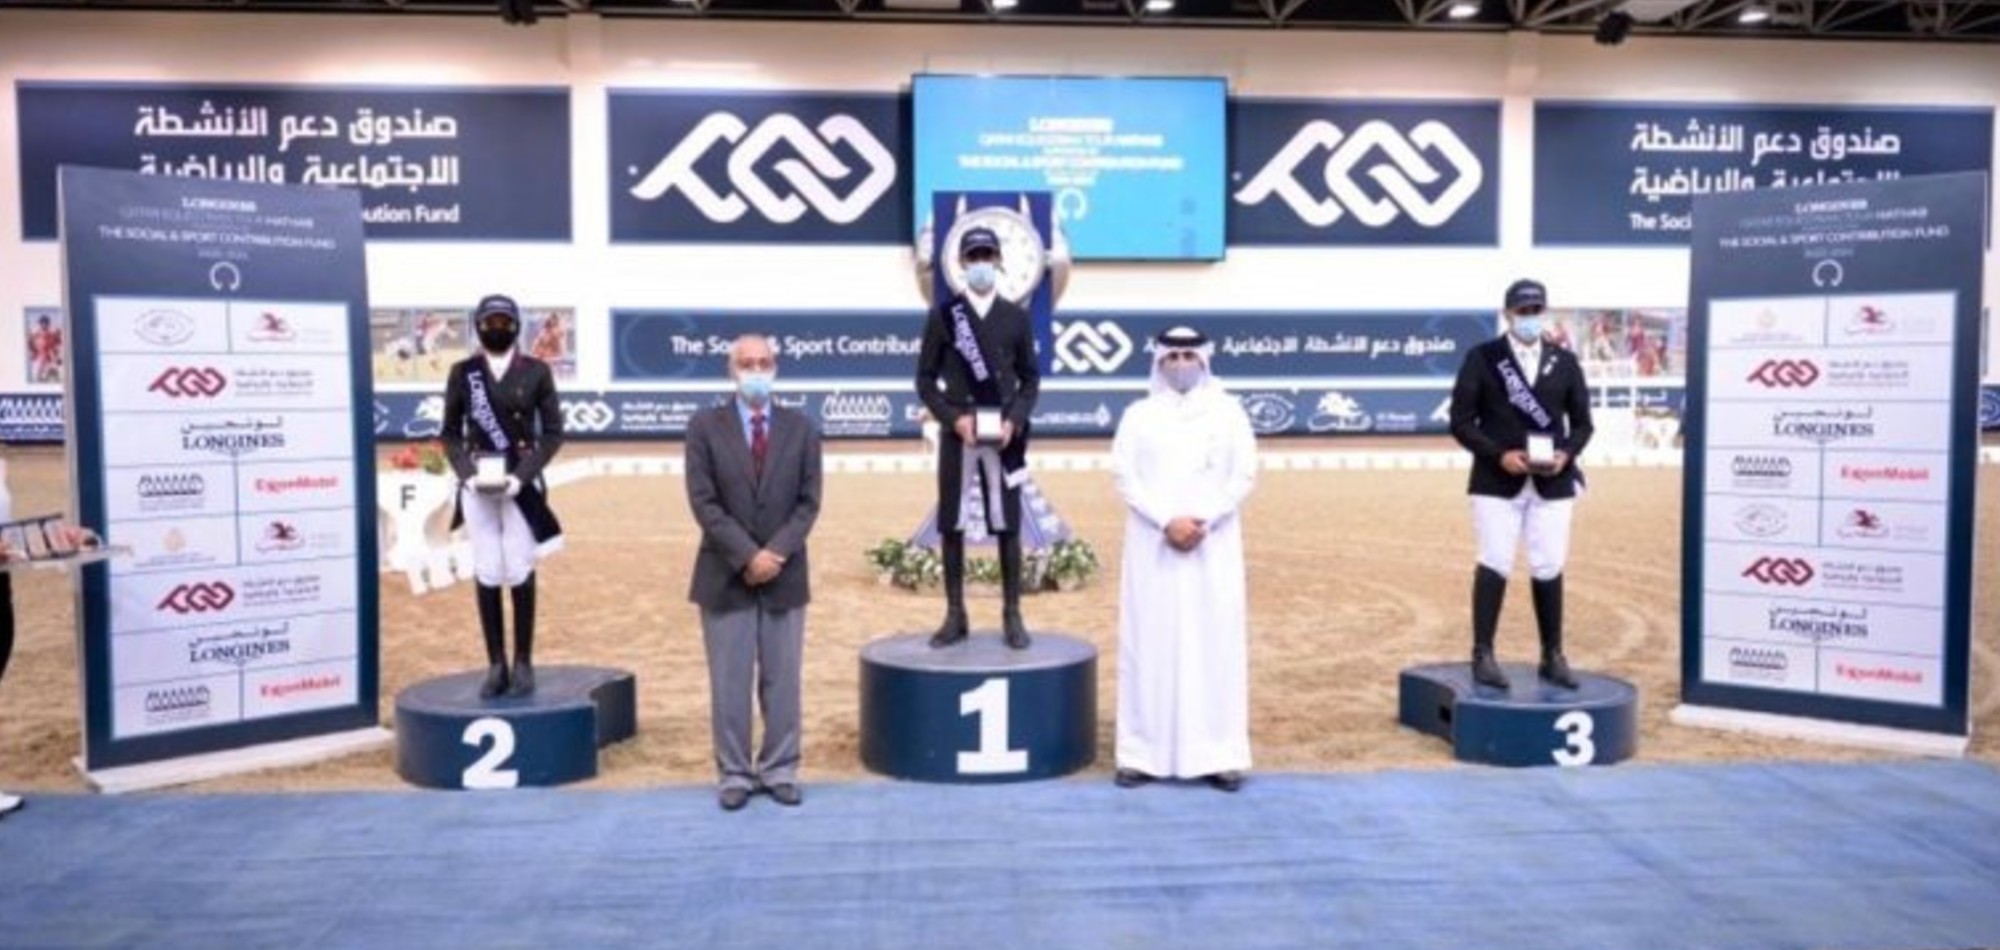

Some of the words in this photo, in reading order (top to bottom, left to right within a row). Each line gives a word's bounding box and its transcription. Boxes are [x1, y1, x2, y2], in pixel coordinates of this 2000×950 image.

[278, 115, 339, 152] دعم
[349, 108, 457, 145] صندوق
[1751, 132, 1802, 167] دعم
[1810, 126, 1901, 160] صندوق
[415, 204, 459, 222] Fund
[1630, 213, 1657, 229] The
[671, 336, 703, 354] The
[784, 336, 833, 360] Sport
[182, 433, 285, 450] LONGINES
[1774, 422, 1874, 437] LONGINES
[401, 486, 417, 509] F
[1769, 618, 1868, 637] LONGINES
[190, 639, 290, 663] LONGINES
[956, 679, 1028, 774] 1
[1552, 711, 1595, 766] 3
[461, 718, 519, 789] 2
